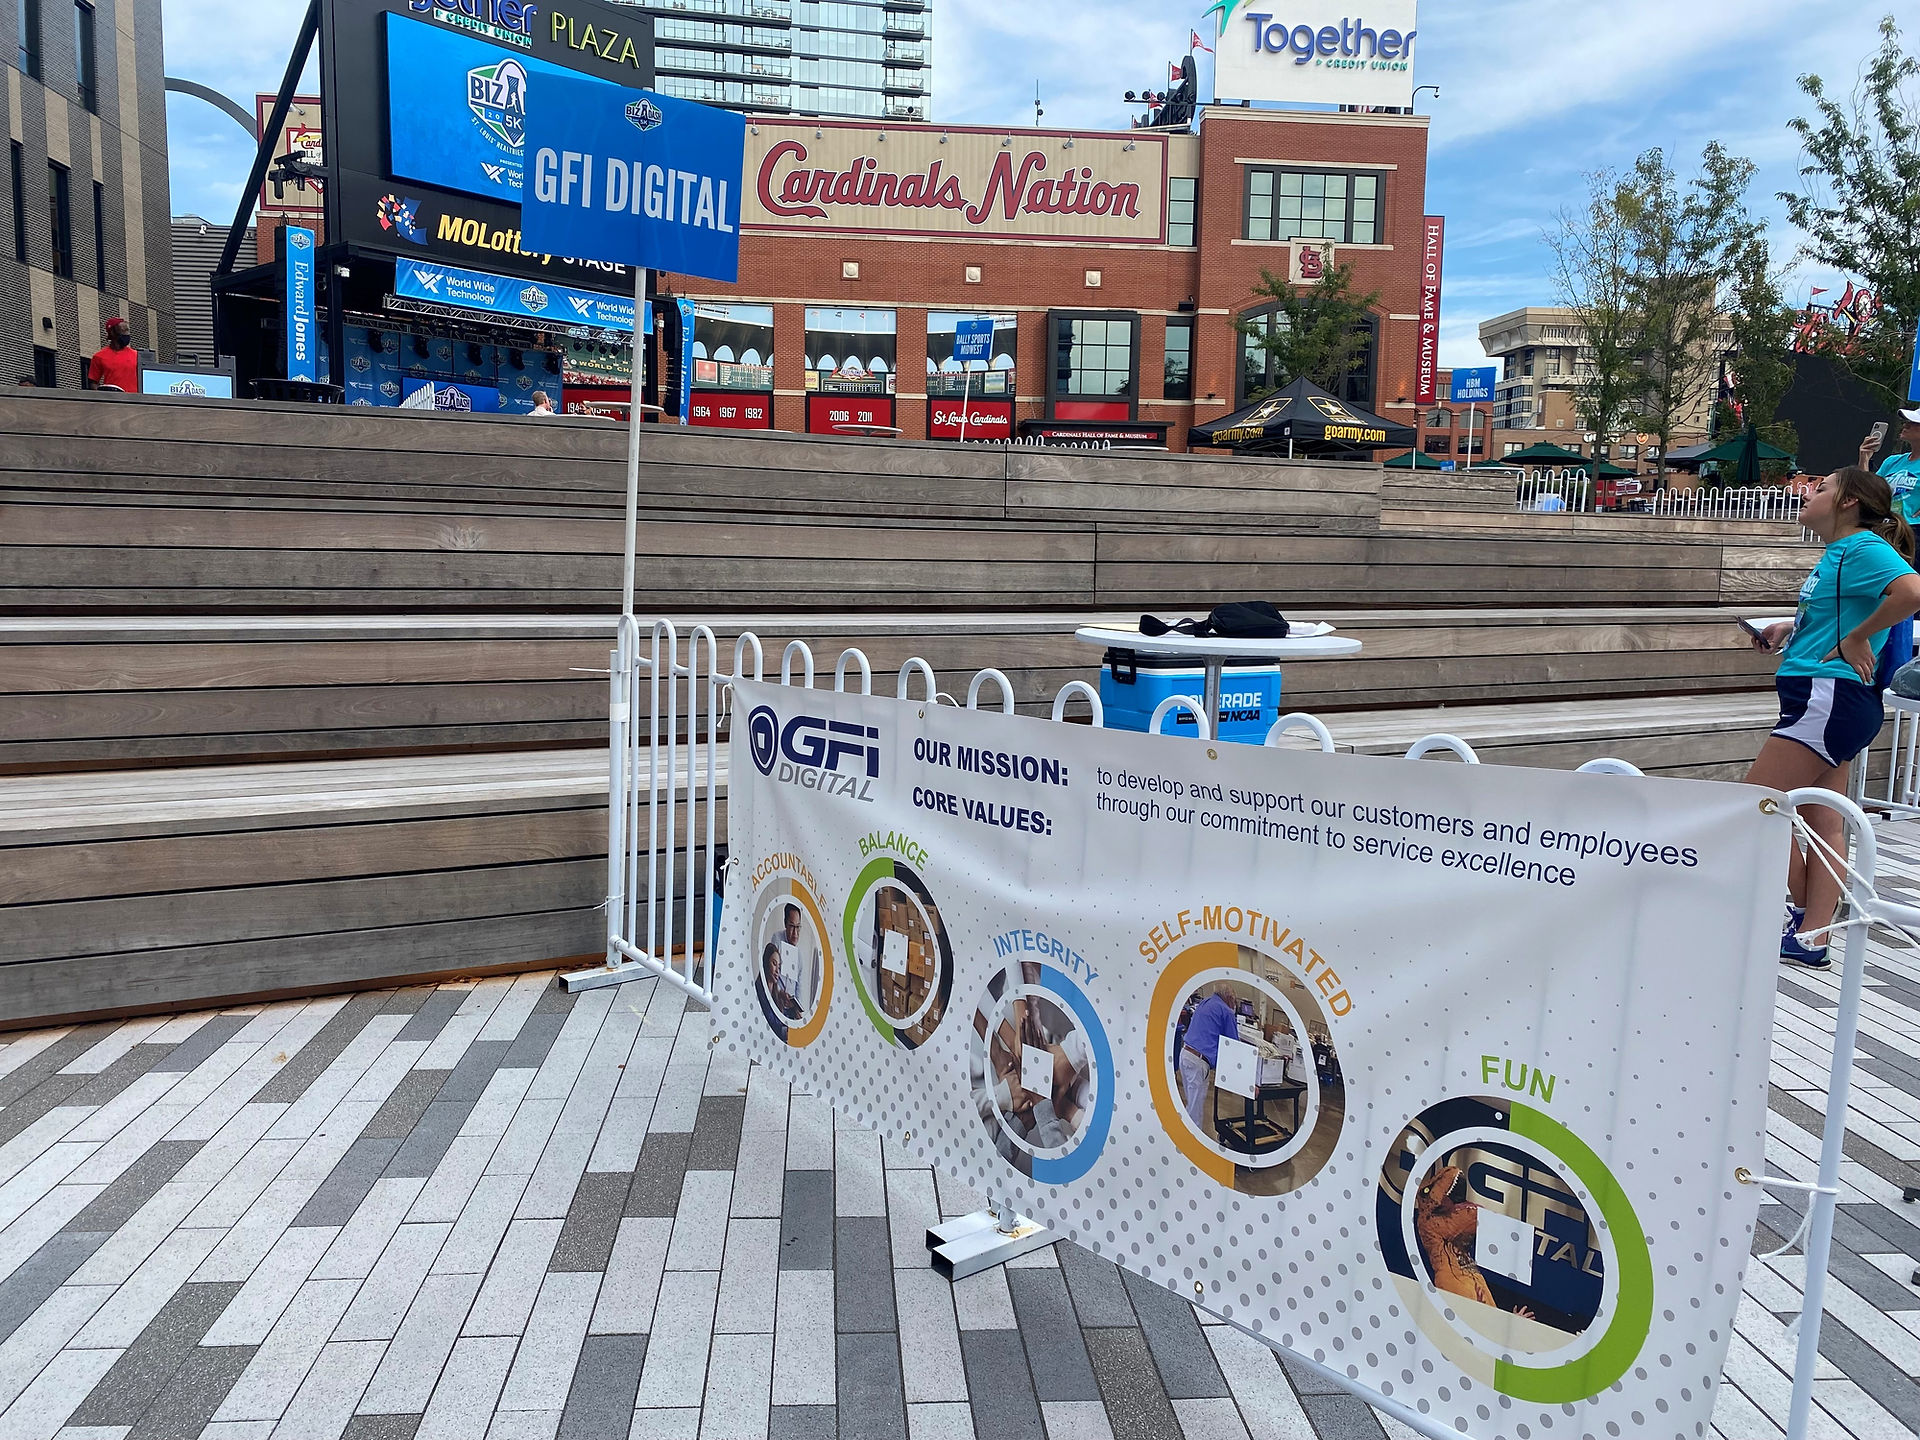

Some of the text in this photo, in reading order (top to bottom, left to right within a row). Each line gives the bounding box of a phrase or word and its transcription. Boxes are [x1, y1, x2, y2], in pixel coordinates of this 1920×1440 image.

[551, 11, 640, 69] PLAZA
[1245, 12, 1418, 65] Together
[1326, 59, 1408, 71] CREDIT UNION
[470, 76, 504, 107] BIZ
[626, 106, 640, 117] BIZ
[505, 115, 522, 131] 5K
[534, 147, 734, 234] GFI DIGITAL
[756, 139, 1143, 226] Cardinals Nation
[445, 276, 495, 293] World Wide
[446, 287, 495, 305] Technology
[596, 301, 617, 312] World
[1420, 225, 1439, 395] HALL OF FAME & MUSEUM
[596, 311, 635, 326] Technolog
[971, 333, 991, 344] SPORTS
[579, 361, 613, 370] WORLD
[192, 387, 205, 395] DASH
[1466, 378, 1480, 388] HBM
[435, 396, 449, 405] BIZ
[1457, 388, 1489, 399] HOLDINGS
[567, 402, 582, 413] 194
[692, 405, 763, 419] 1964 1967 1982
[829, 410, 873, 422] 2006 2011
[933, 410, 947, 424] St.
[970, 411, 1008, 426] Cardinals
[1212, 426, 1264, 444] goarmy.com
[1324, 425, 1386, 443] goarmy.com
[1230, 709, 1260, 722] NCAA
[914, 737, 1069, 787] OUR MISSION:
[778, 762, 874, 803] DIGITAL
[912, 786, 1053, 836] CORE VALUES:
[1097, 767, 1699, 868] to develop and support our customers and employees
[1097, 792, 1576, 887] through our commitment to service excellence
[858, 830, 929, 871] BALANCE
[751, 852, 828, 913] ACCOUNTABLE
[993, 929, 1099, 987] INTEGRITY
[1138, 905, 1353, 1018] SELF-MOTIVATED
[1481, 1055, 1557, 1104] FUN
